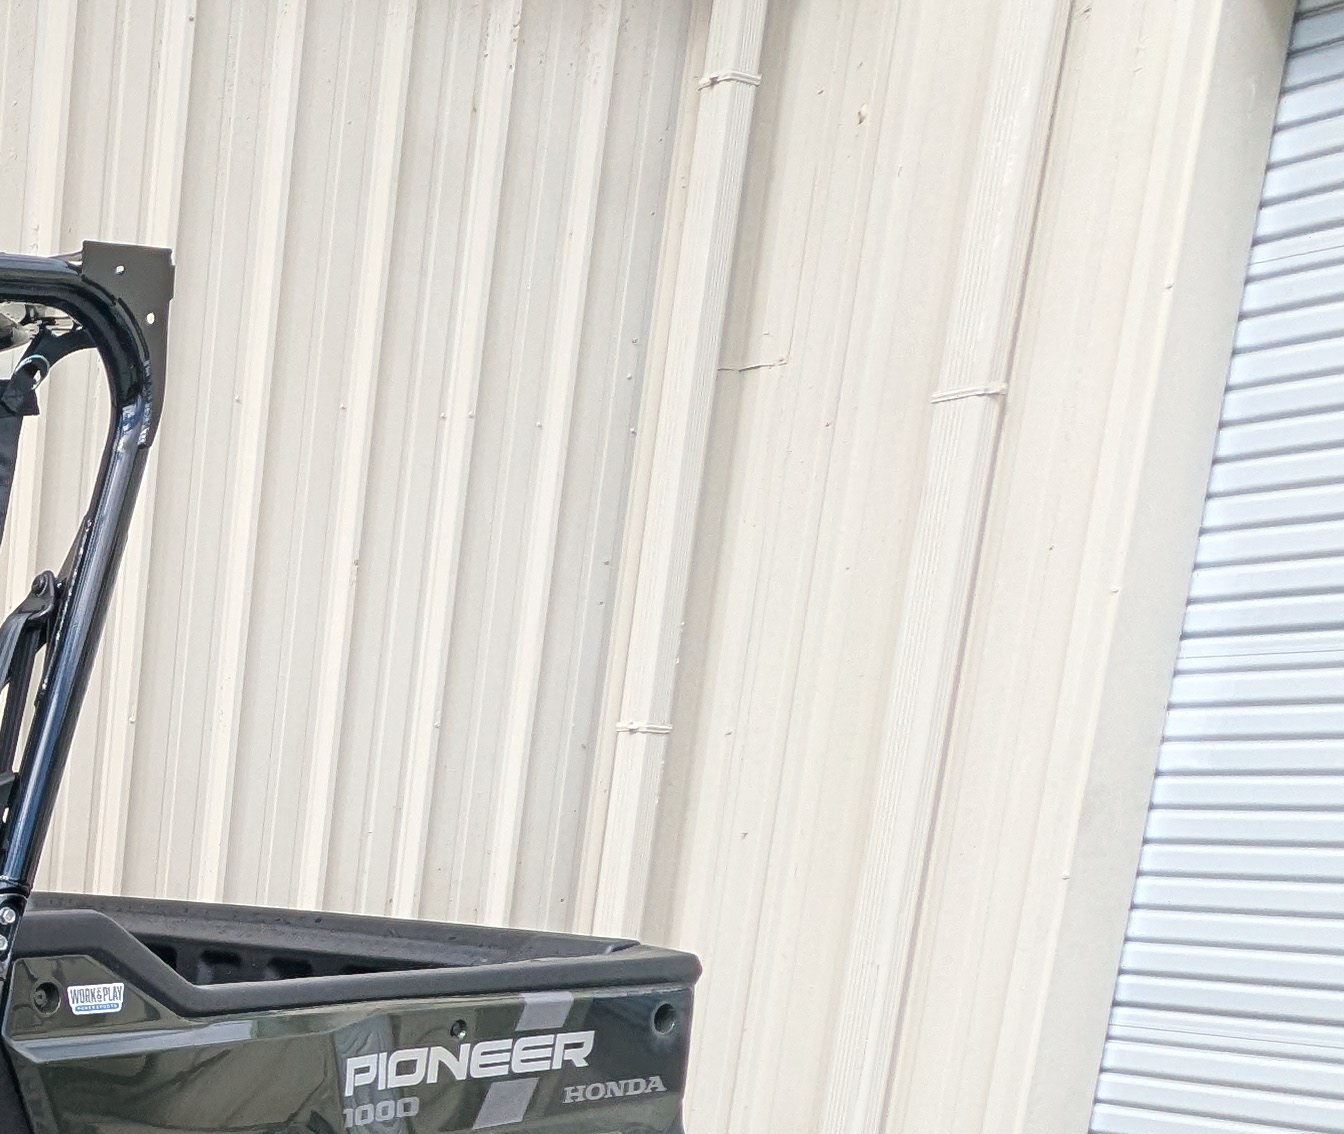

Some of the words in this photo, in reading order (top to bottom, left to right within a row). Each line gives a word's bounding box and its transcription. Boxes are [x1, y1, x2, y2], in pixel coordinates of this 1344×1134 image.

[344, 1030, 596, 1097] PIONEER
[562, 1075, 668, 1104] HONDA
[343, 1096, 420, 1128] 1000
